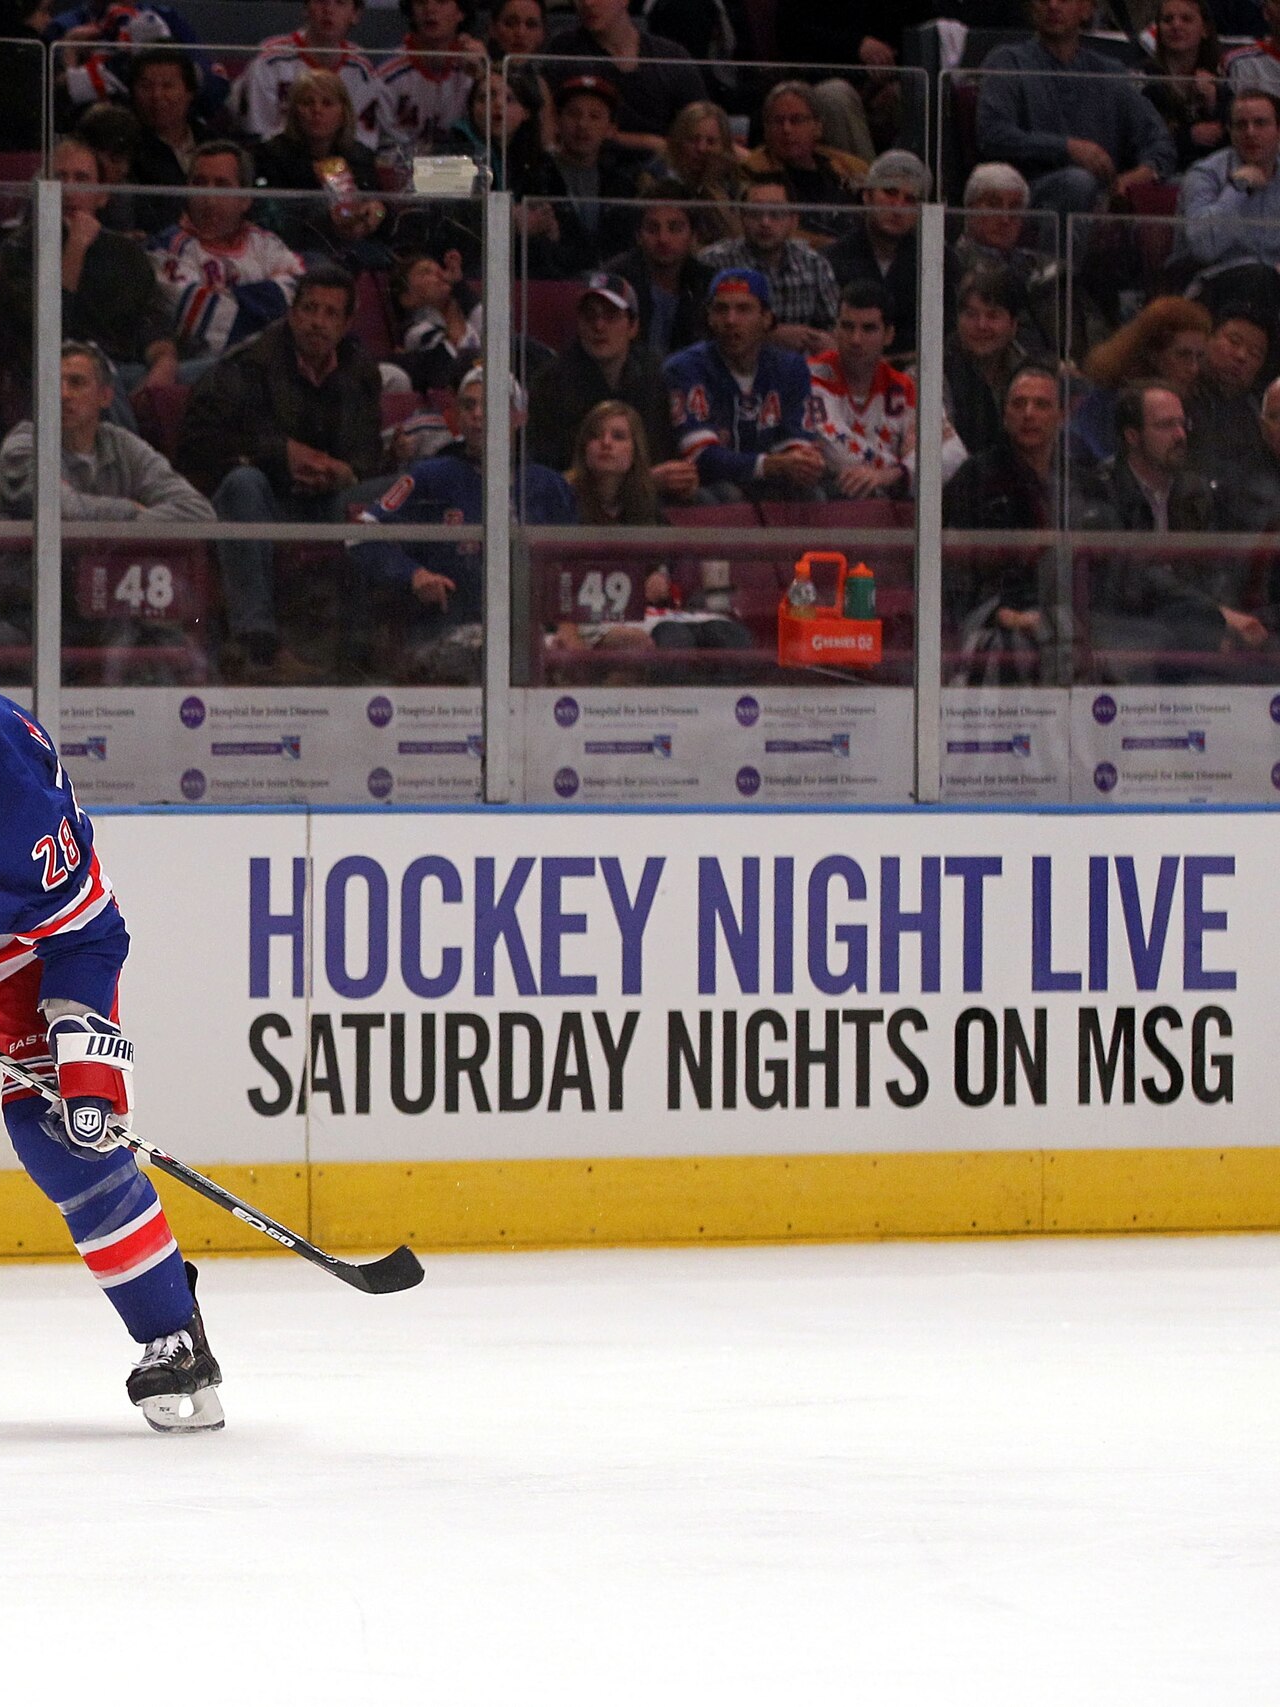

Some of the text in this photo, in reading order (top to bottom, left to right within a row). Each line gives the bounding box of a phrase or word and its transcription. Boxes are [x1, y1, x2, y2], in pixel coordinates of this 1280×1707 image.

[114, 564, 174, 609] 48
[578, 571, 632, 613] 49
[31, 816, 82, 890] 28
[249, 855, 1236, 998] HOCKEY NIGHT LIVE
[247, 1004, 1237, 1117] SATURDAY NIGHTS ON MSG
